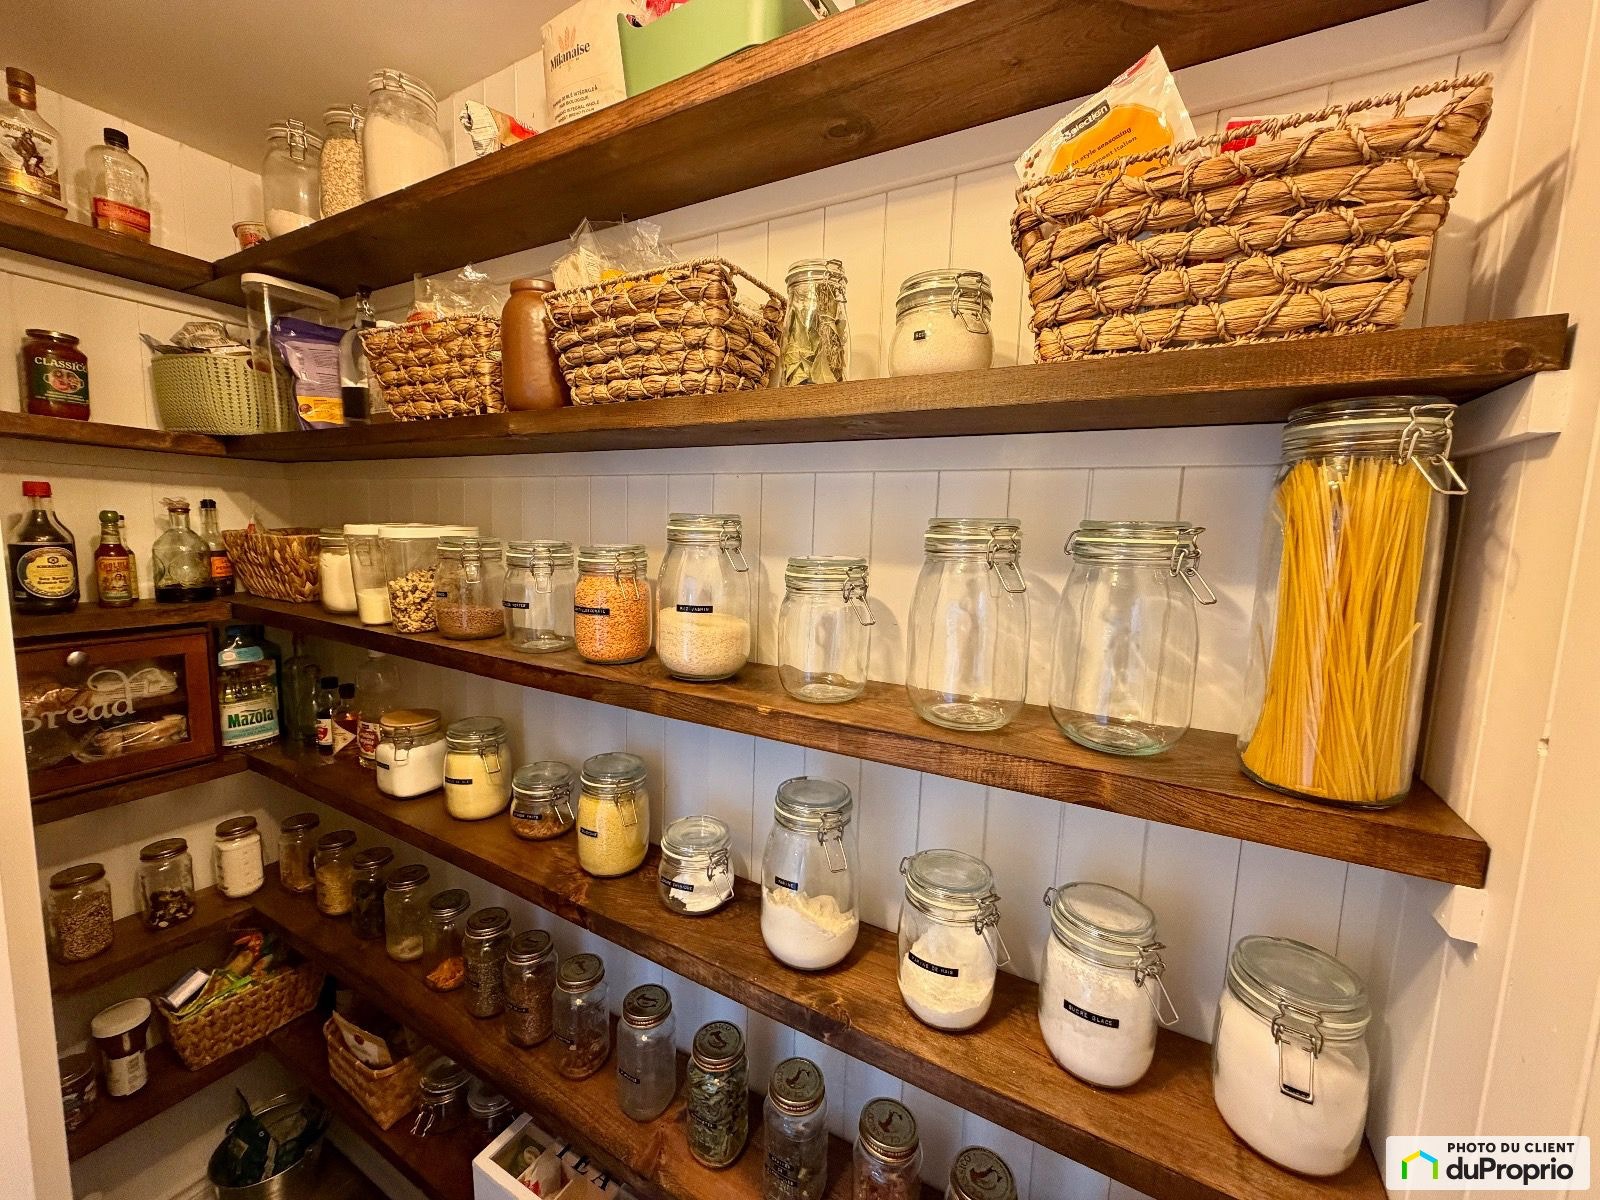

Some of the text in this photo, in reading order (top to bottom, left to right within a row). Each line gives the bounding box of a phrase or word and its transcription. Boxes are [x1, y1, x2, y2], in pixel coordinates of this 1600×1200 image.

[550, 42, 591, 72] Milanaise
[1080, 149, 1097, 162] style
[1097, 126, 1132, 151] seasoning
[34, 356, 87, 373] CLASSIC
[227, 708, 274, 728] Mazola
[1068, 1004, 1112, 1026] SUCRE GLACE
